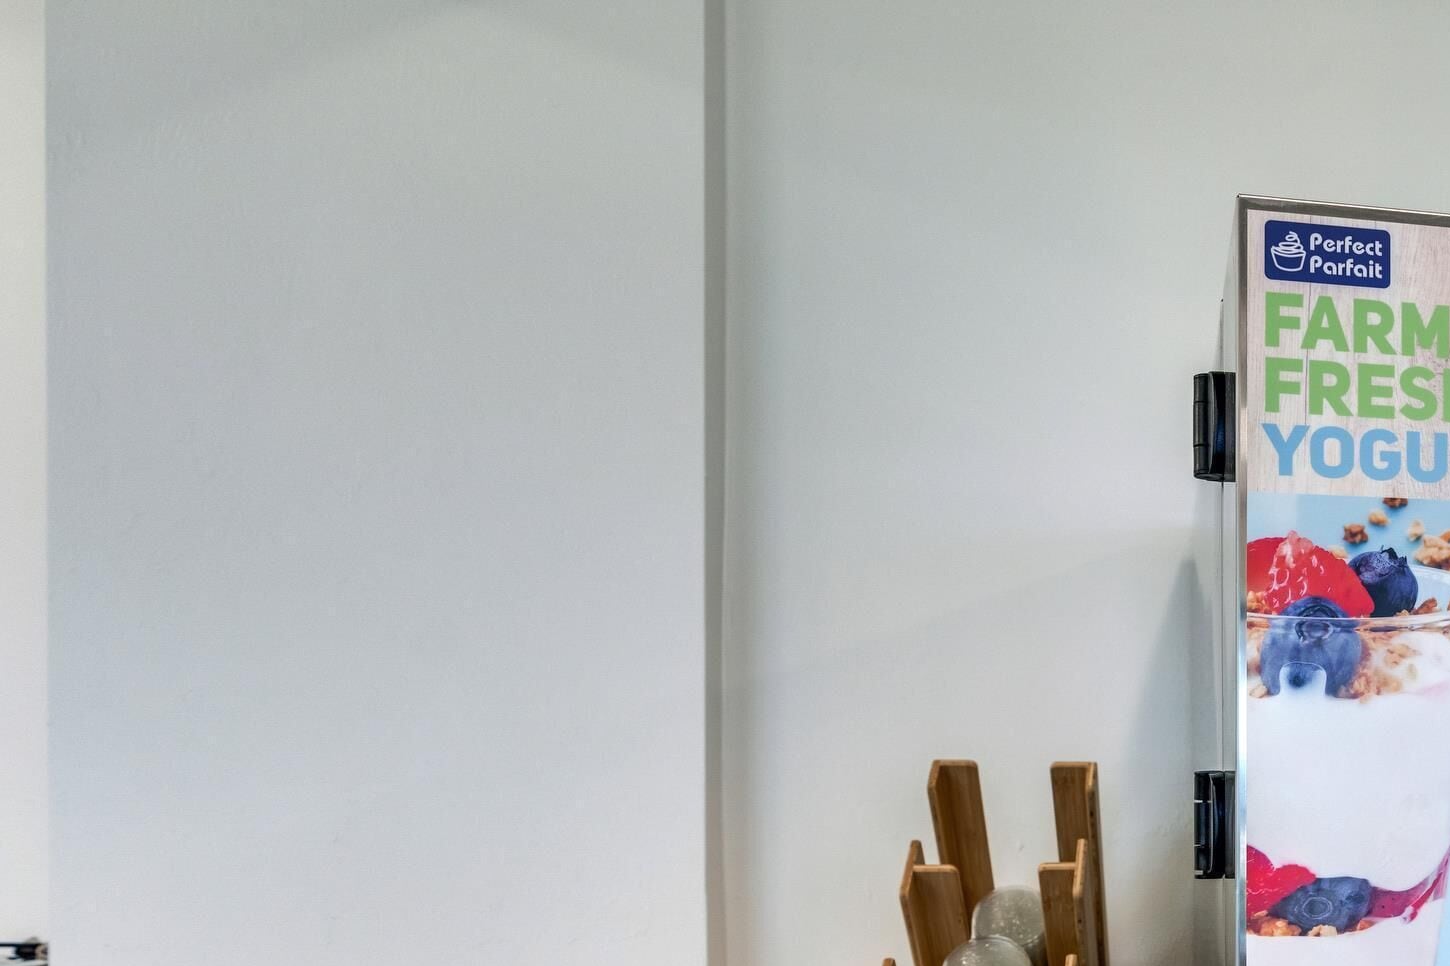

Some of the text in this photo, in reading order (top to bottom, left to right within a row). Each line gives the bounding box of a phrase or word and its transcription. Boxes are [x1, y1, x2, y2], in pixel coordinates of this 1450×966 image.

[1310, 233, 1383, 256] Perfect
[1309, 256, 1383, 279] Parfait
[1265, 292, 1450, 359] FARM
